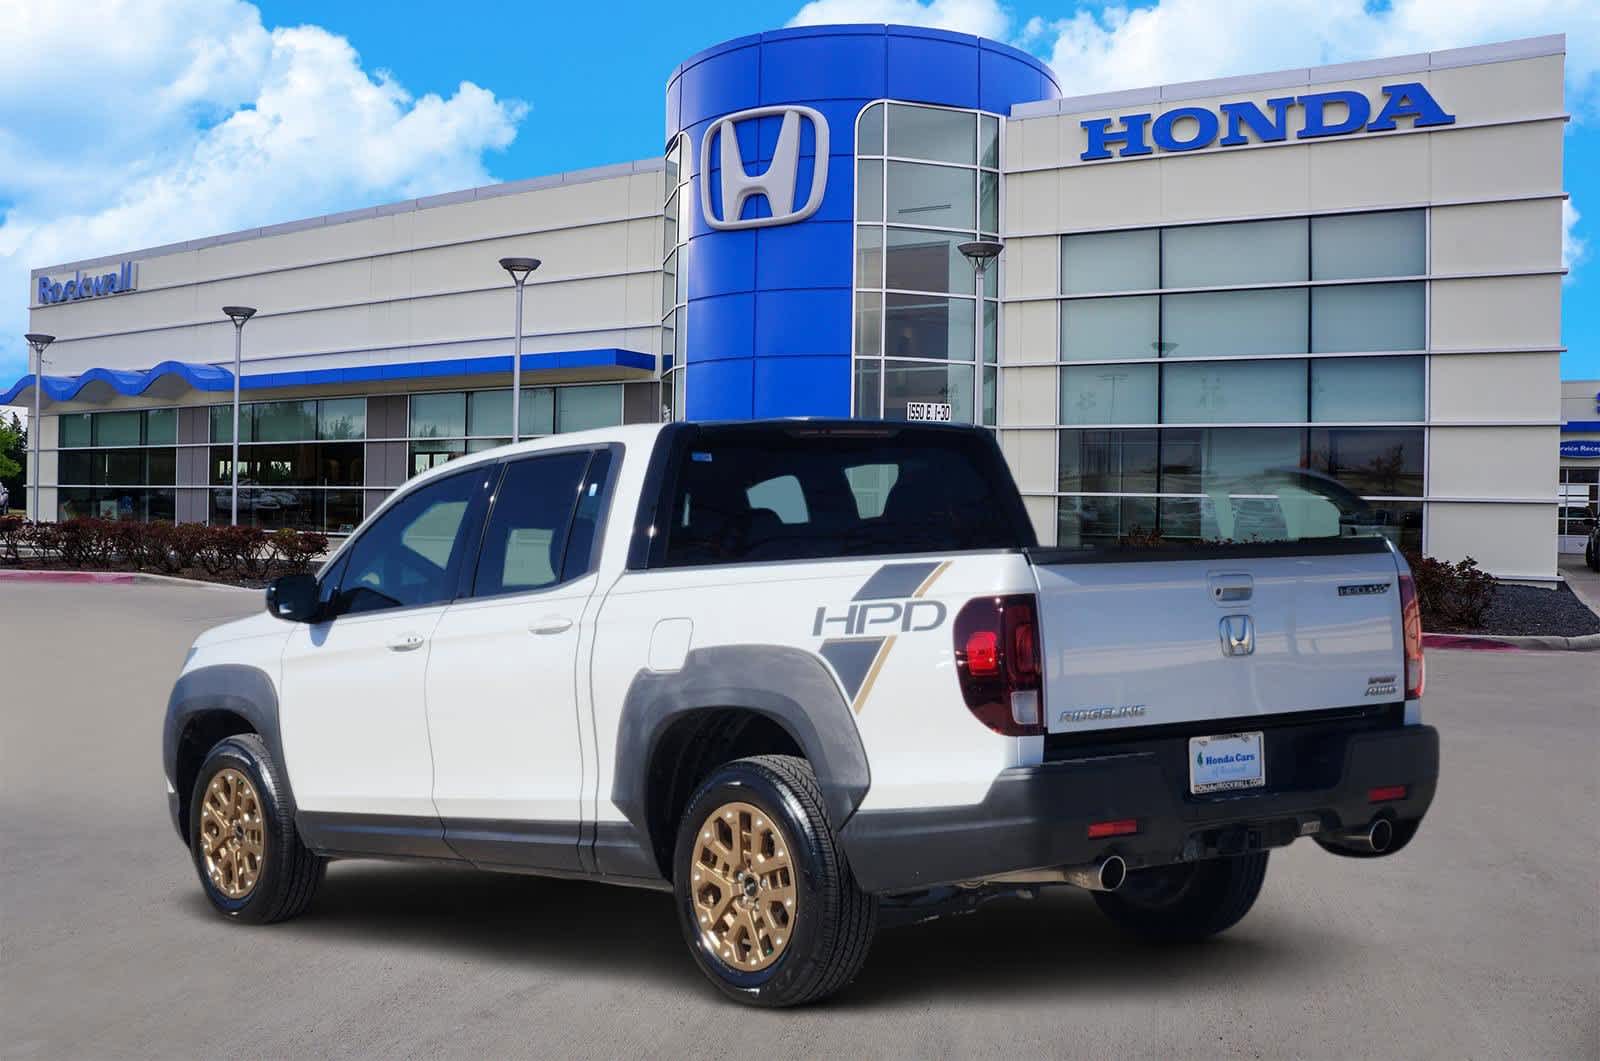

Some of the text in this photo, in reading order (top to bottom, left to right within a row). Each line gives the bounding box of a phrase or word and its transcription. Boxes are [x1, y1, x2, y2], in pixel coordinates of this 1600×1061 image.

[1080, 82, 1456, 161] HONDA
[908, 403, 924, 420] 1550
[934, 404, 950, 421] I-30
[812, 600, 947, 636] HPD
[1059, 704, 1146, 722] RIDGELINE
[1206, 752, 1256, 765] Honda Cars
